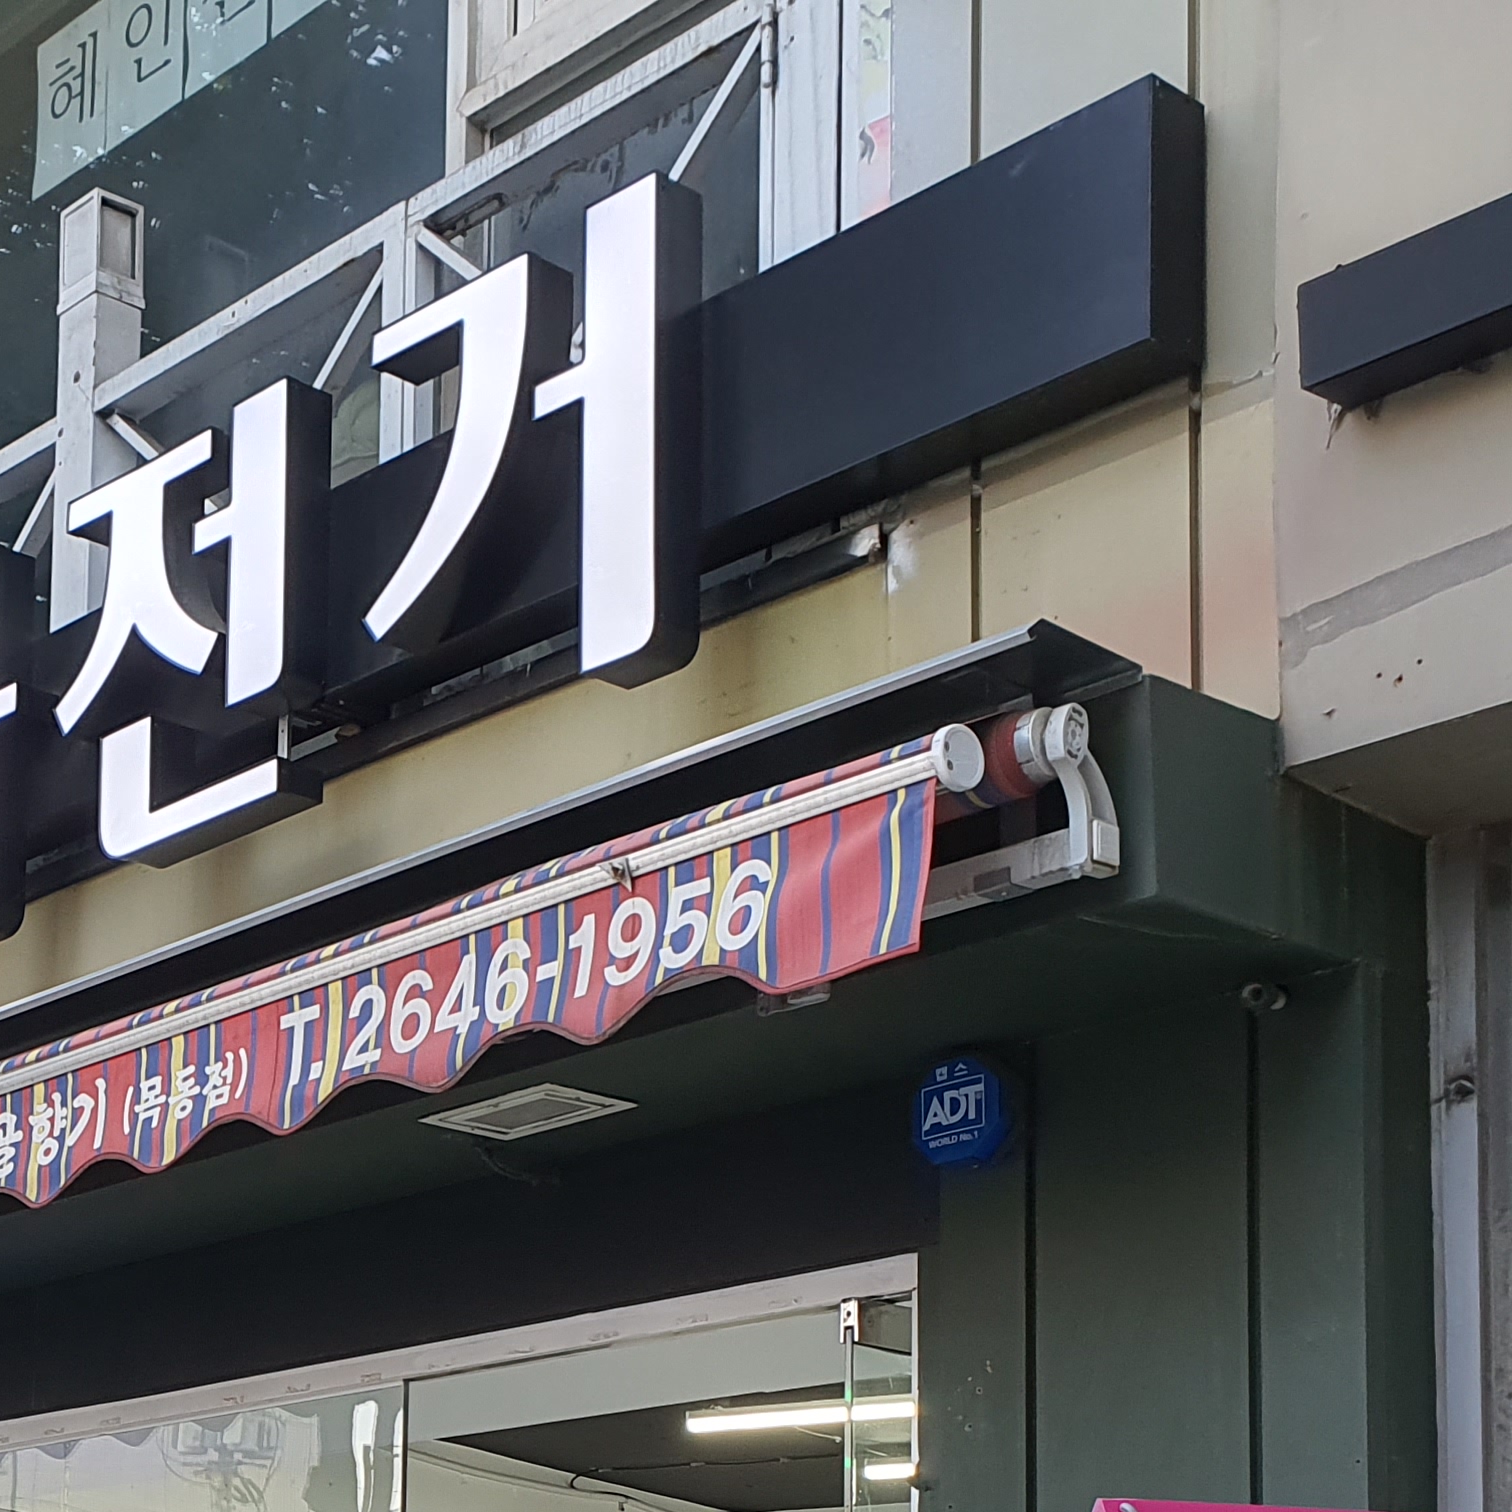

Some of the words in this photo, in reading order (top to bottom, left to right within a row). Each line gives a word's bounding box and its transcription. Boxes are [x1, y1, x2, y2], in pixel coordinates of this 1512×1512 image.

[123, 1047, 249, 1135] (목동점)
[922, 1083, 984, 1132] ADT
[928, 1134, 958, 1149] WORLD
